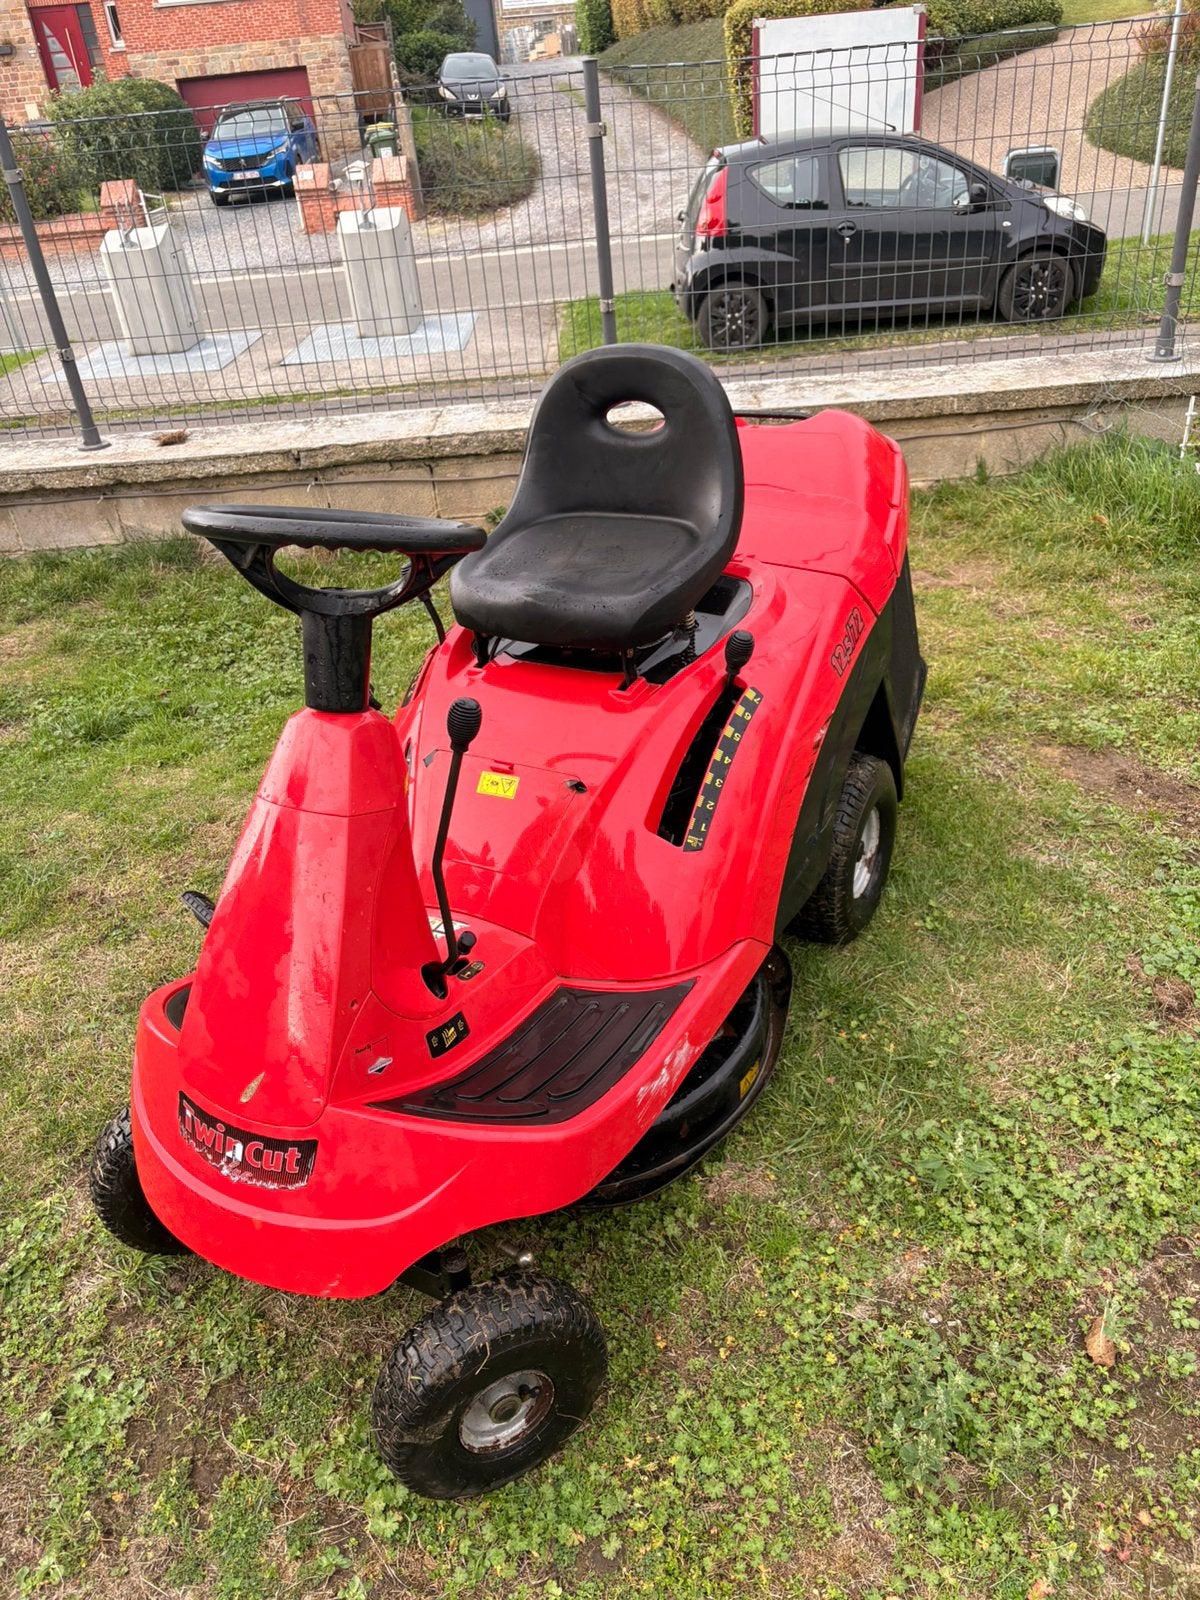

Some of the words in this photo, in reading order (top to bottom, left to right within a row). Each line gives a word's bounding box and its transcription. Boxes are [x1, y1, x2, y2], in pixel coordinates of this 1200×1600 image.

[753, 697, 761, 705] 7
[733, 732, 741, 742] 5
[723, 756, 732, 764] 4
[715, 778, 723, 788] 3
[706, 800, 715, 810] 2
